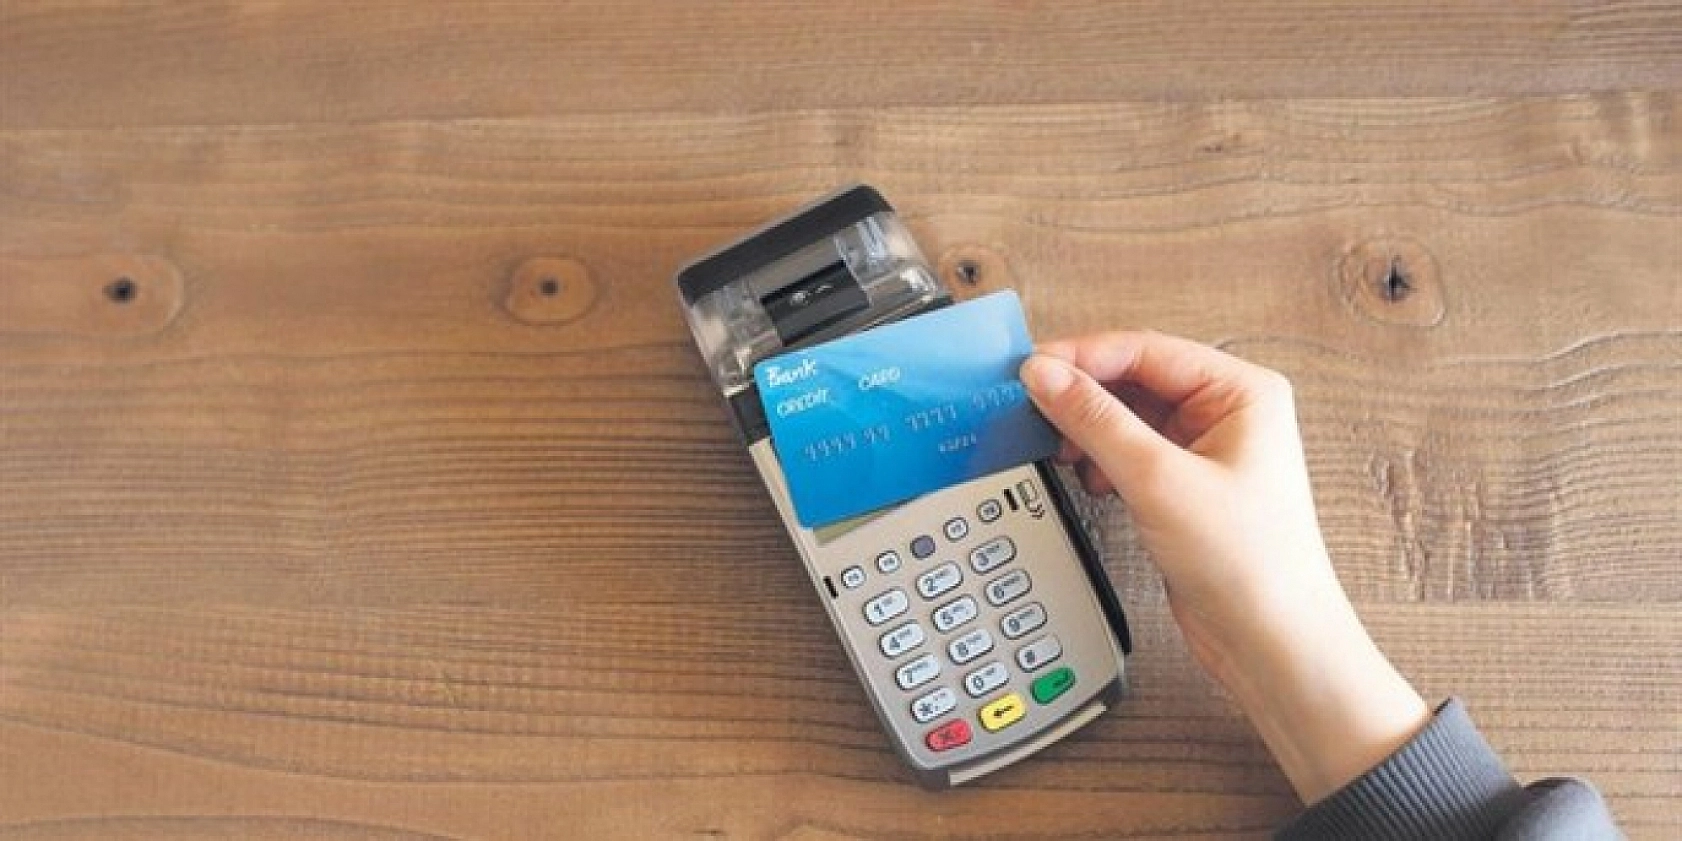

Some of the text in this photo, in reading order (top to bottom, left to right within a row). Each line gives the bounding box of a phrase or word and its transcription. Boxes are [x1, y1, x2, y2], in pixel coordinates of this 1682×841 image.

[777, 388, 829, 418] CREDIT
[925, 576, 937, 592] 2
[873, 604, 885, 616] 1
[904, 669, 914, 683] 7
[972, 675, 984, 689] 0
